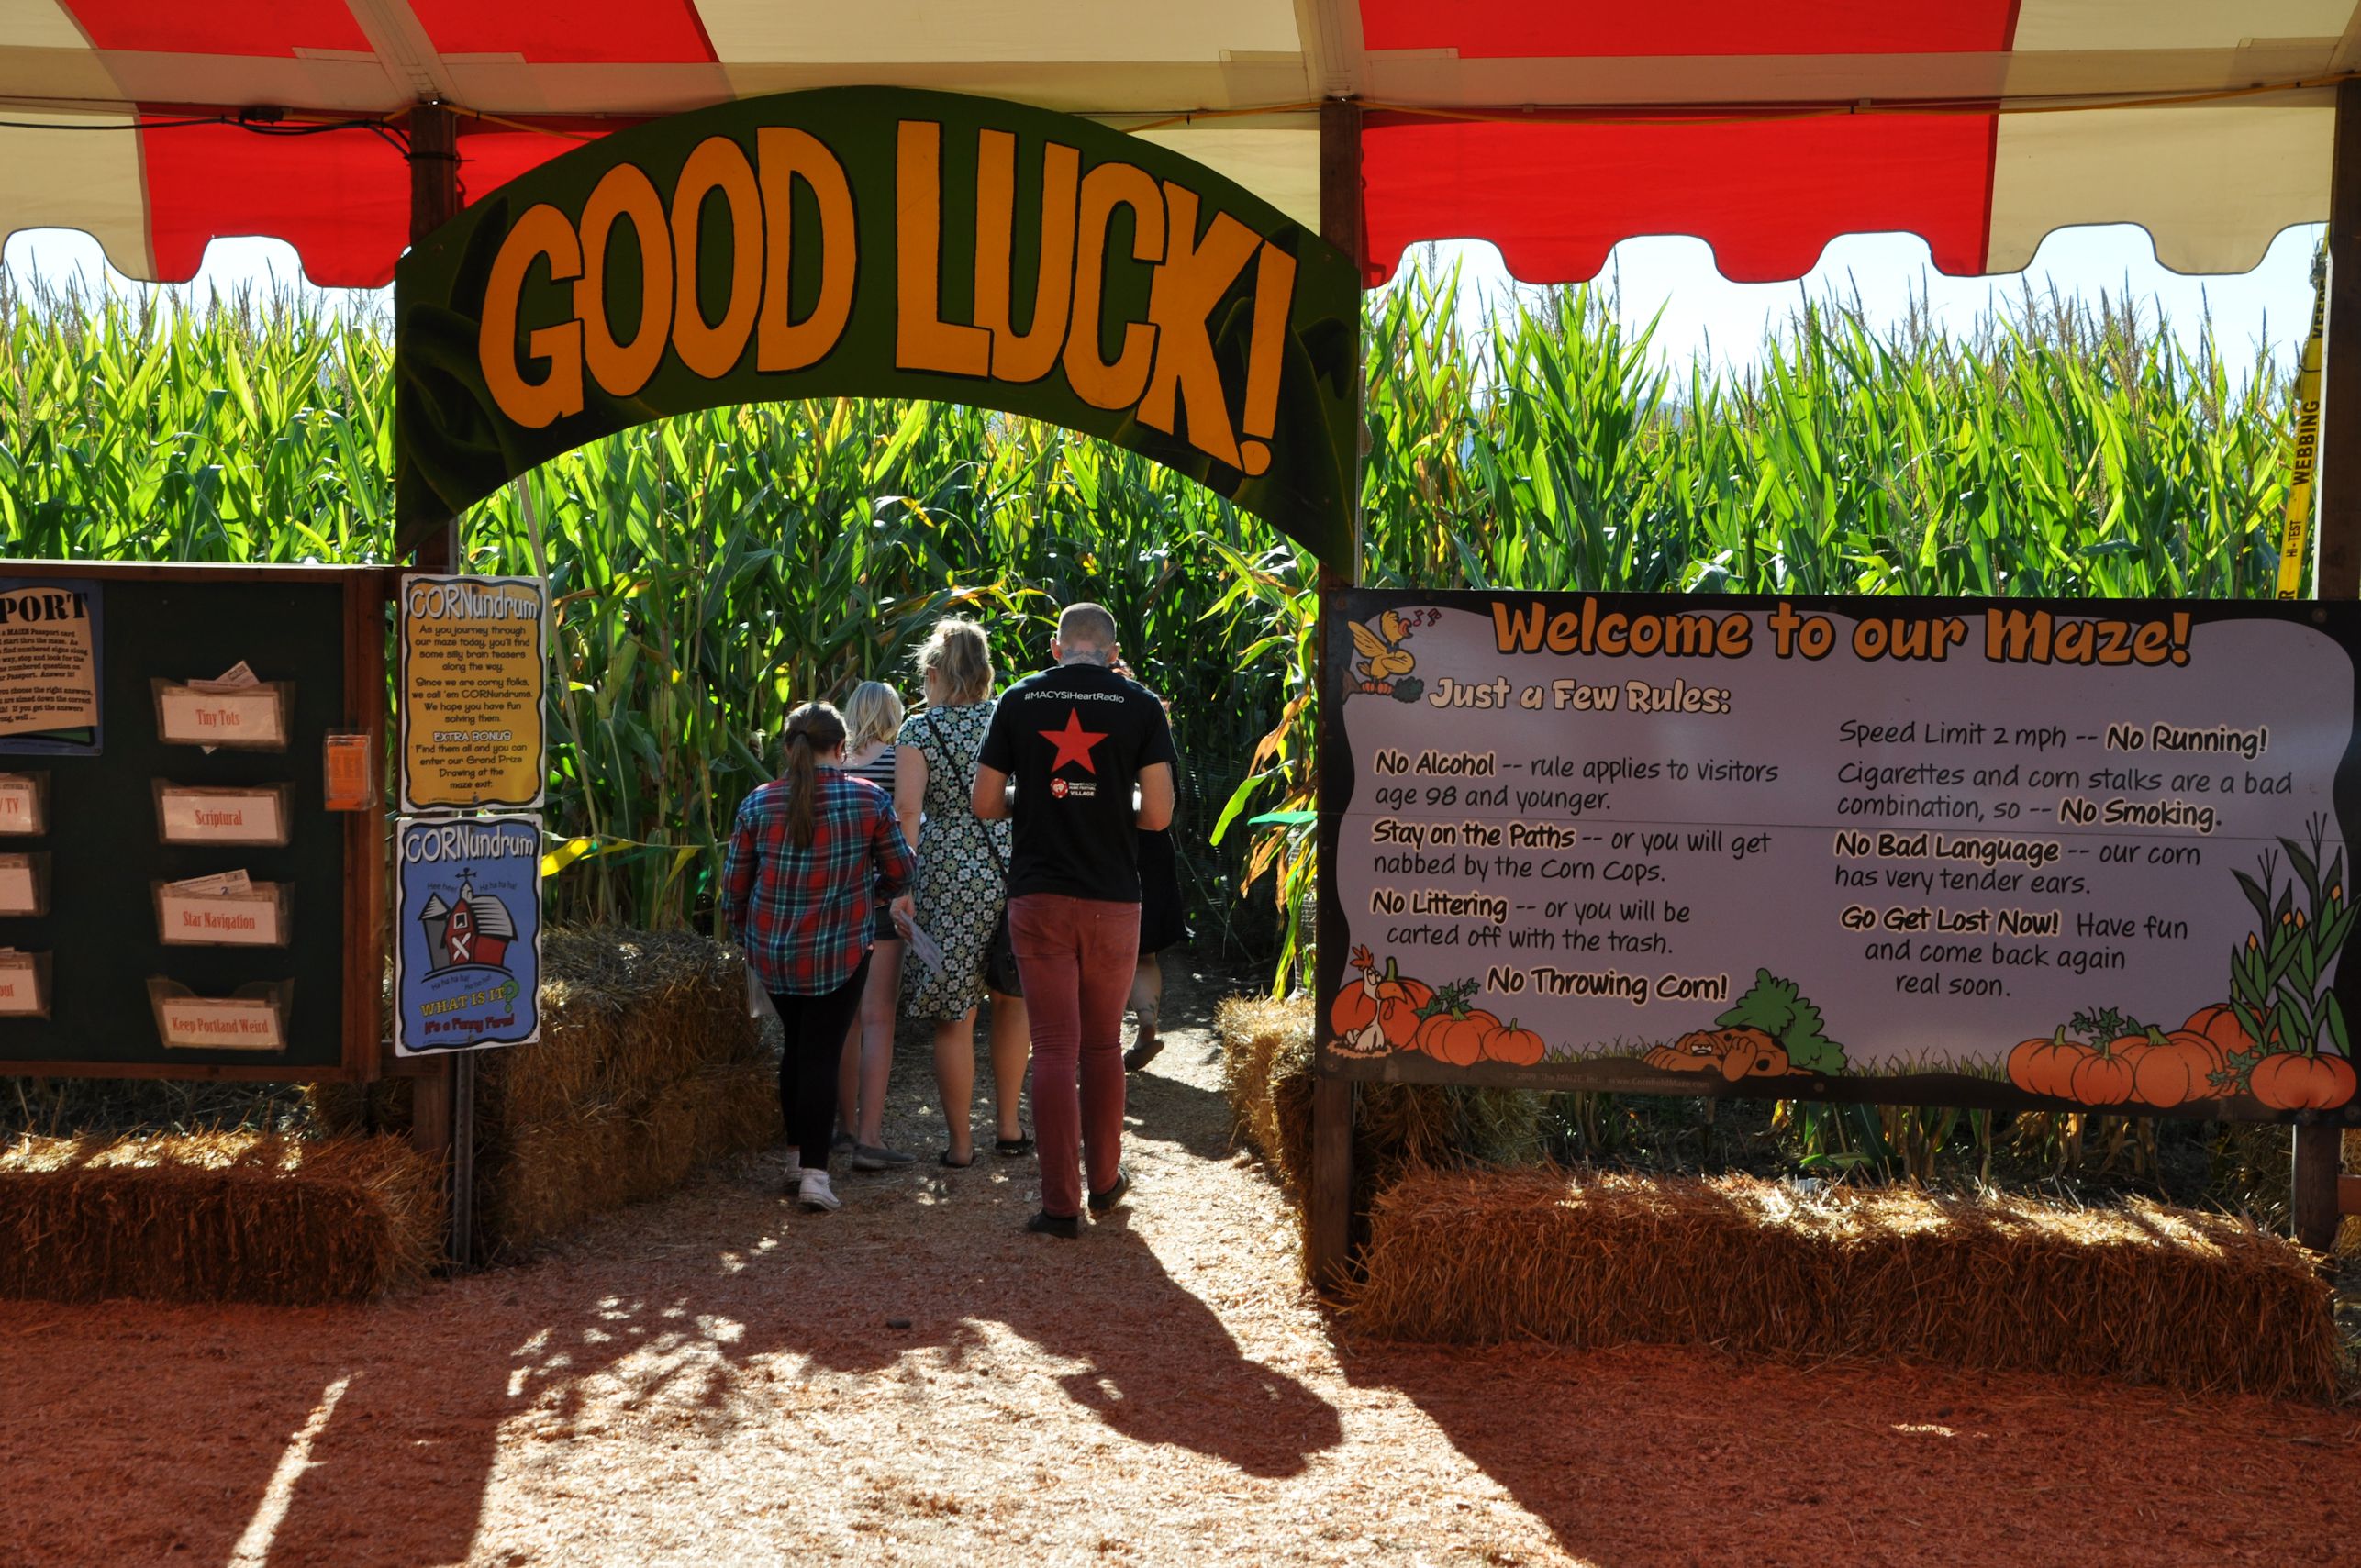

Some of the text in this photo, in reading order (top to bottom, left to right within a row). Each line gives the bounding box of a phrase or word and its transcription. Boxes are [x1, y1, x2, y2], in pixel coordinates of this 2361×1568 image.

[477, 117, 1297, 477] GOOD LUCK!
[2292, 400, 2320, 486] WEBBING
[0, 592, 88, 623] PORT
[410, 584, 538, 620] CORNundrum
[435, 628, 451, 636] you
[451, 626, 488, 636] journey
[492, 626, 525, 637] through
[489, 639, 511, 649] you'll
[1491, 596, 2193, 667] Welcome to our Maze!
[442, 662, 466, 673] along
[447, 651, 462, 661] silly
[416, 677, 441, 686] Since
[477, 680, 504, 689] corny
[1024, 691, 1125, 703] #MACYSiHeartRadio
[1429, 677, 1732, 714] Just a Few Rules:
[196, 709, 240, 727] Tiny Tots
[424, 703, 438, 711] We
[440, 703, 462, 712] hope
[465, 704, 481, 713] you
[507, 702, 521, 710] fun
[445, 716, 474, 725] solving
[433, 731, 512, 742] EXTRA BONUS
[493, 745, 508, 754] you
[1839, 721, 2266, 760] Speed Limit 2 mph No Running!
[440, 768, 474, 779] Drawing
[466, 755, 496, 764] Grand
[499, 755, 522, 763] Prize
[1375, 751, 1778, 784] No Alcohol rule applies to visitors
[1838, 762, 2291, 795] Cigarettes and corn stalks are a bad
[1376, 785, 1610, 815] age 98 and younger.
[1837, 794, 2222, 833] combination, so No Smoking.
[195, 809, 242, 828] Scriptural
[406, 826, 534, 863] CORNundrum
[1374, 820, 1772, 860] Stay on the Paths or you will get
[1834, 832, 2200, 868] No Bad Language our corn
[1375, 852, 1455, 874] nabbed
[1465, 855, 1489, 883] by
[1494, 857, 1531, 877] the
[1603, 862, 1665, 885] Cops.
[1835, 863, 2090, 895] has very tender ears.
[183, 911, 255, 930] Star Navigation
[1371, 892, 1690, 923] No Littering or you will be
[1841, 906, 2188, 940] Go Get Lost Now! Have fun
[1387, 925, 1673, 953] carted off with the trash.
[1865, 942, 2125, 974] and come back again
[1487, 967, 1524, 993] No
[1531, 969, 1648, 1003] Throwing
[1897, 973, 2010, 997] real soon.
[420, 994, 468, 1017] WHAT
[471, 992, 485, 1006] IS
[172, 1017, 268, 1033] Keep Portland Weird
[1541, 1073, 1554, 1082] The
